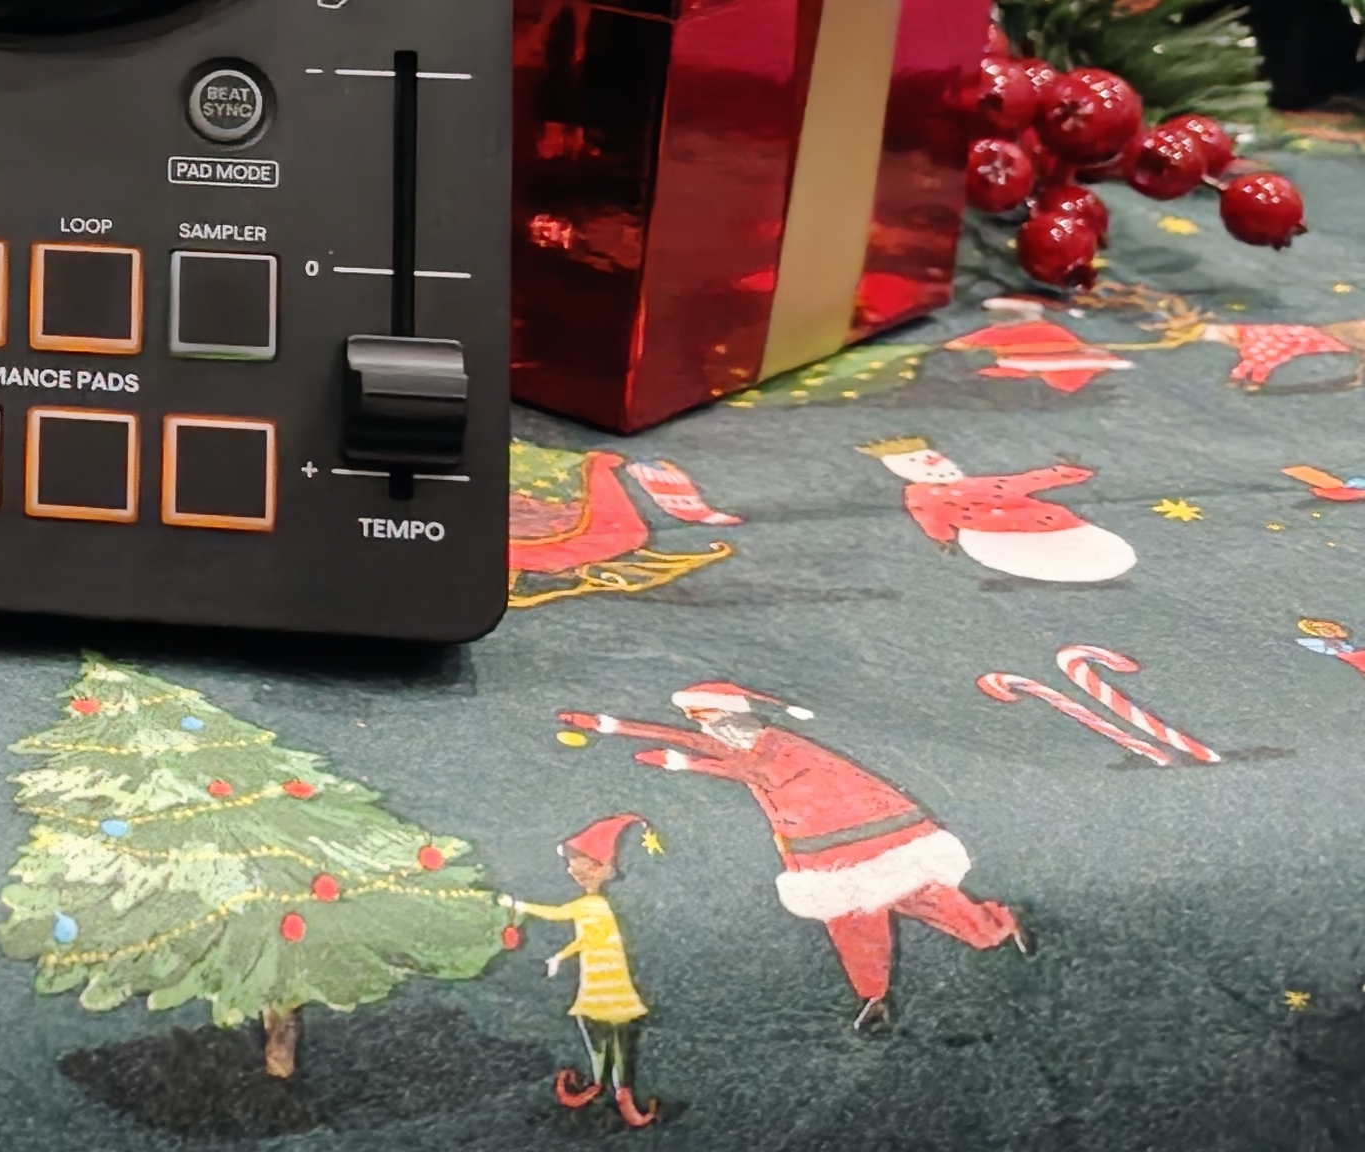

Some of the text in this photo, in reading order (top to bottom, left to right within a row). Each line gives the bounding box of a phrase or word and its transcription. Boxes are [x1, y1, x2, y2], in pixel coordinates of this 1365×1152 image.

[207, 86, 250, 101] BEAT
[202, 102, 253, 118] SYNC
[176, 162, 271, 181] PAD MODE
[60, 217, 113, 234] LOOP
[179, 222, 267, 242] SAMPLER
[77, 370, 140, 393] PADS
[357, 517, 445, 542] TEMPO
